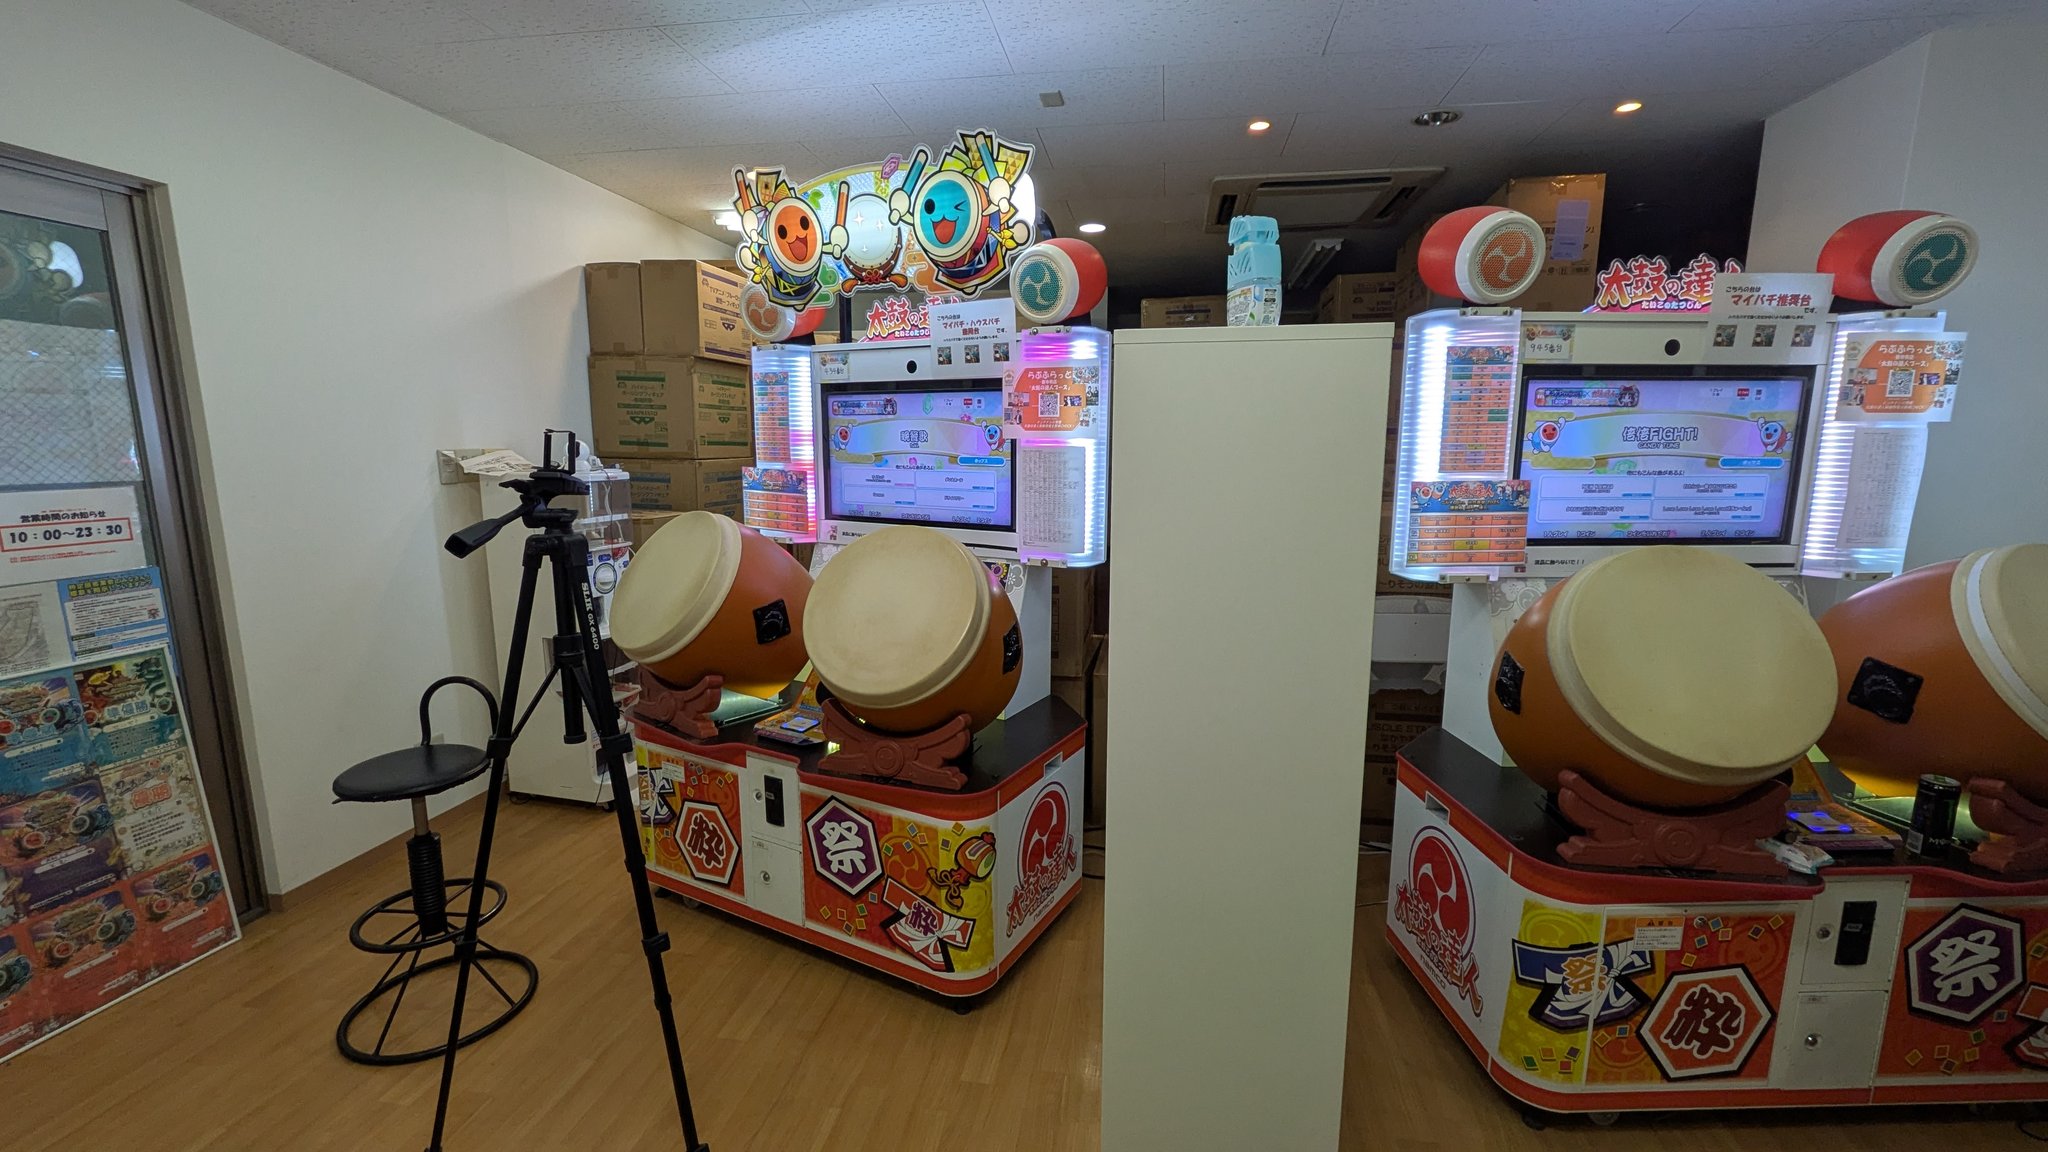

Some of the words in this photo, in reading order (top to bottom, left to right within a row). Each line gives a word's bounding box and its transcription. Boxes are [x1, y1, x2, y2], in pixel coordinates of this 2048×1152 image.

[1599, 256, 1743, 308] 太鼓の達
[1731, 293, 1812, 307] マイバチ推奨台
[1641, 300, 1702, 310] たいこのたつじん
[1622, 426, 1698, 442] 倍倍FIGHT!
[20, 510, 107, 524] 営業時間のお知らせ
[581, 582, 594, 612] SLIK
[820, 820, 866, 874] 祭
[1006, 833, 1078, 938] 太鼓の達人
[1394, 879, 1484, 1017] 太鼓の達人
[1929, 929, 2000, 1002] 祭
[1420, 954, 1447, 990] namco
